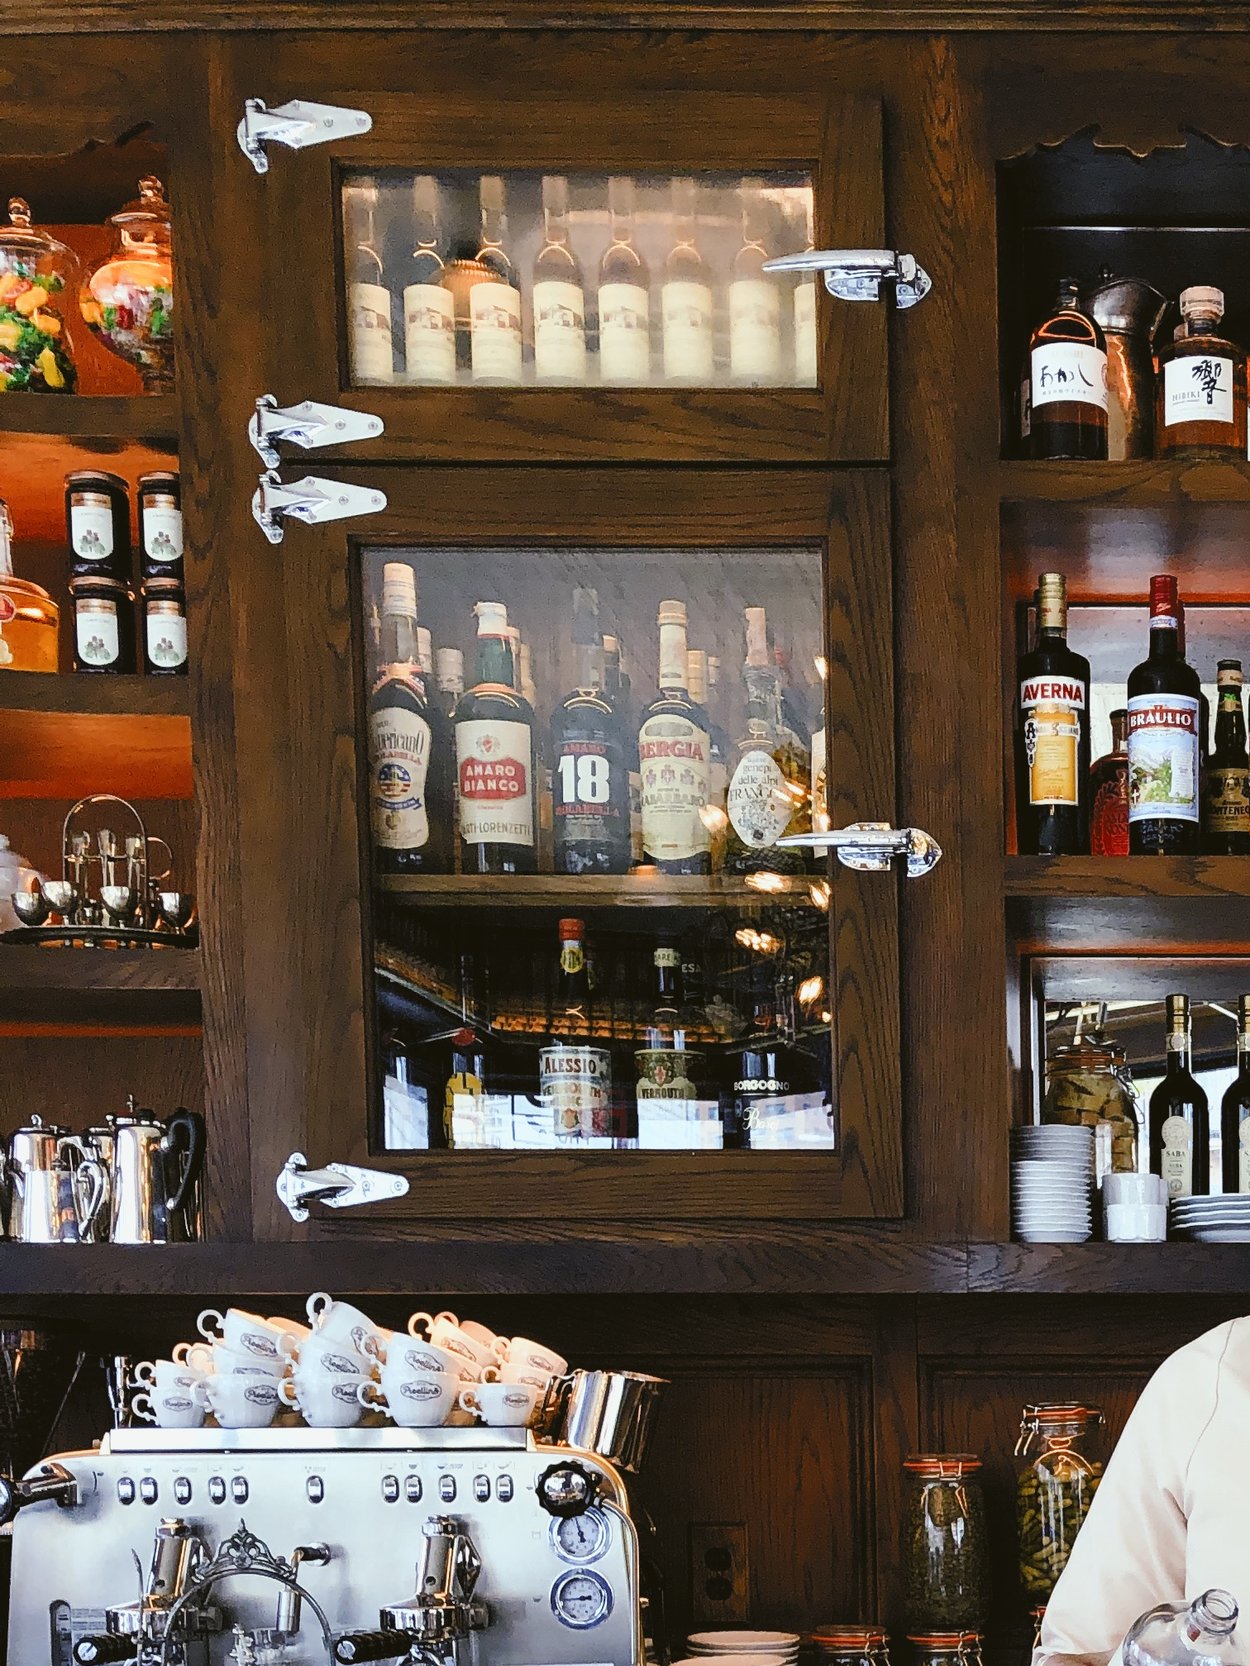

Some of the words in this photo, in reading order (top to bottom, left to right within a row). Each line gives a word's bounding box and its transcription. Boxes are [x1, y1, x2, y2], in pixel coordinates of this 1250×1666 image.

[1171, 391, 1200, 402] HIBIKI
[1023, 683, 1083, 703] AVERNA
[466, 764, 516, 777] AMARO
[464, 779, 519, 792] BIANCO
[557, 754, 610, 804] 18
[545, 1057, 597, 1074] ALESSIO
[733, 1079, 790, 1091] BORGOGNO
[641, 1087, 685, 1099] VERMOUTH
